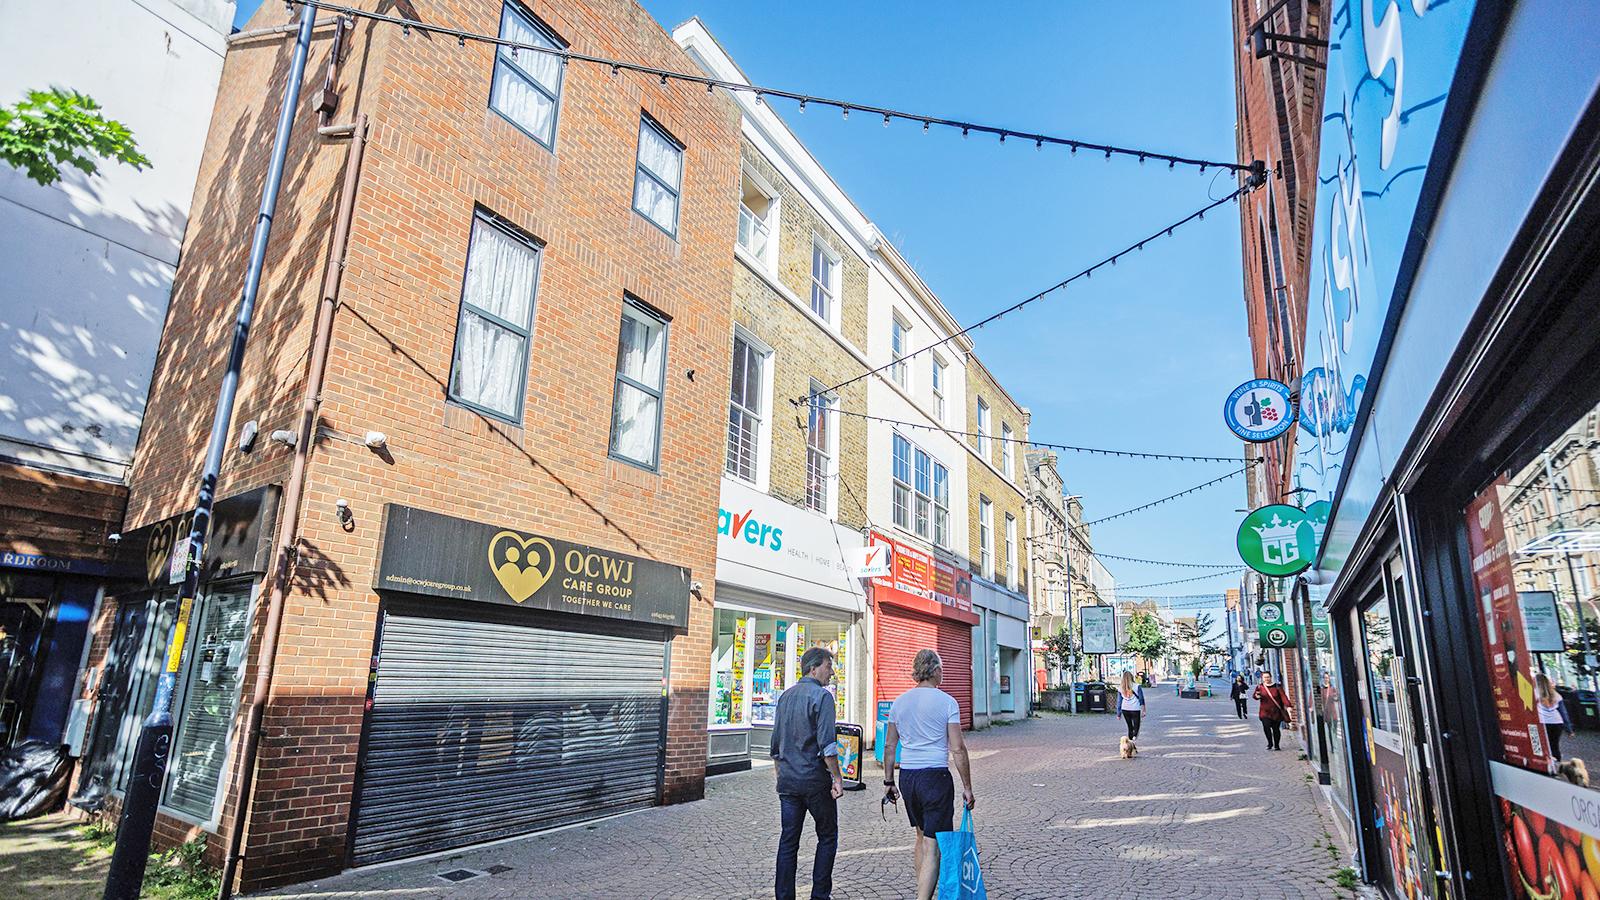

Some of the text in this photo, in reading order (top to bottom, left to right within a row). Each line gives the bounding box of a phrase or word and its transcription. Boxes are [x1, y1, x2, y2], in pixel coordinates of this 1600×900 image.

[1232, 380, 1285, 399] WINE & SPIRITS
[1235, 419, 1290, 439] FINE SELECTION
[787, 547, 809, 560] HEALTH
[815, 556, 831, 568] HOME
[1261, 538, 1300, 566] CG
[564, 549, 635, 585] OCWJ
[562, 577, 633, 598] CARE GROUP
[562, 594, 632, 612] TOGETHER WE CARE
